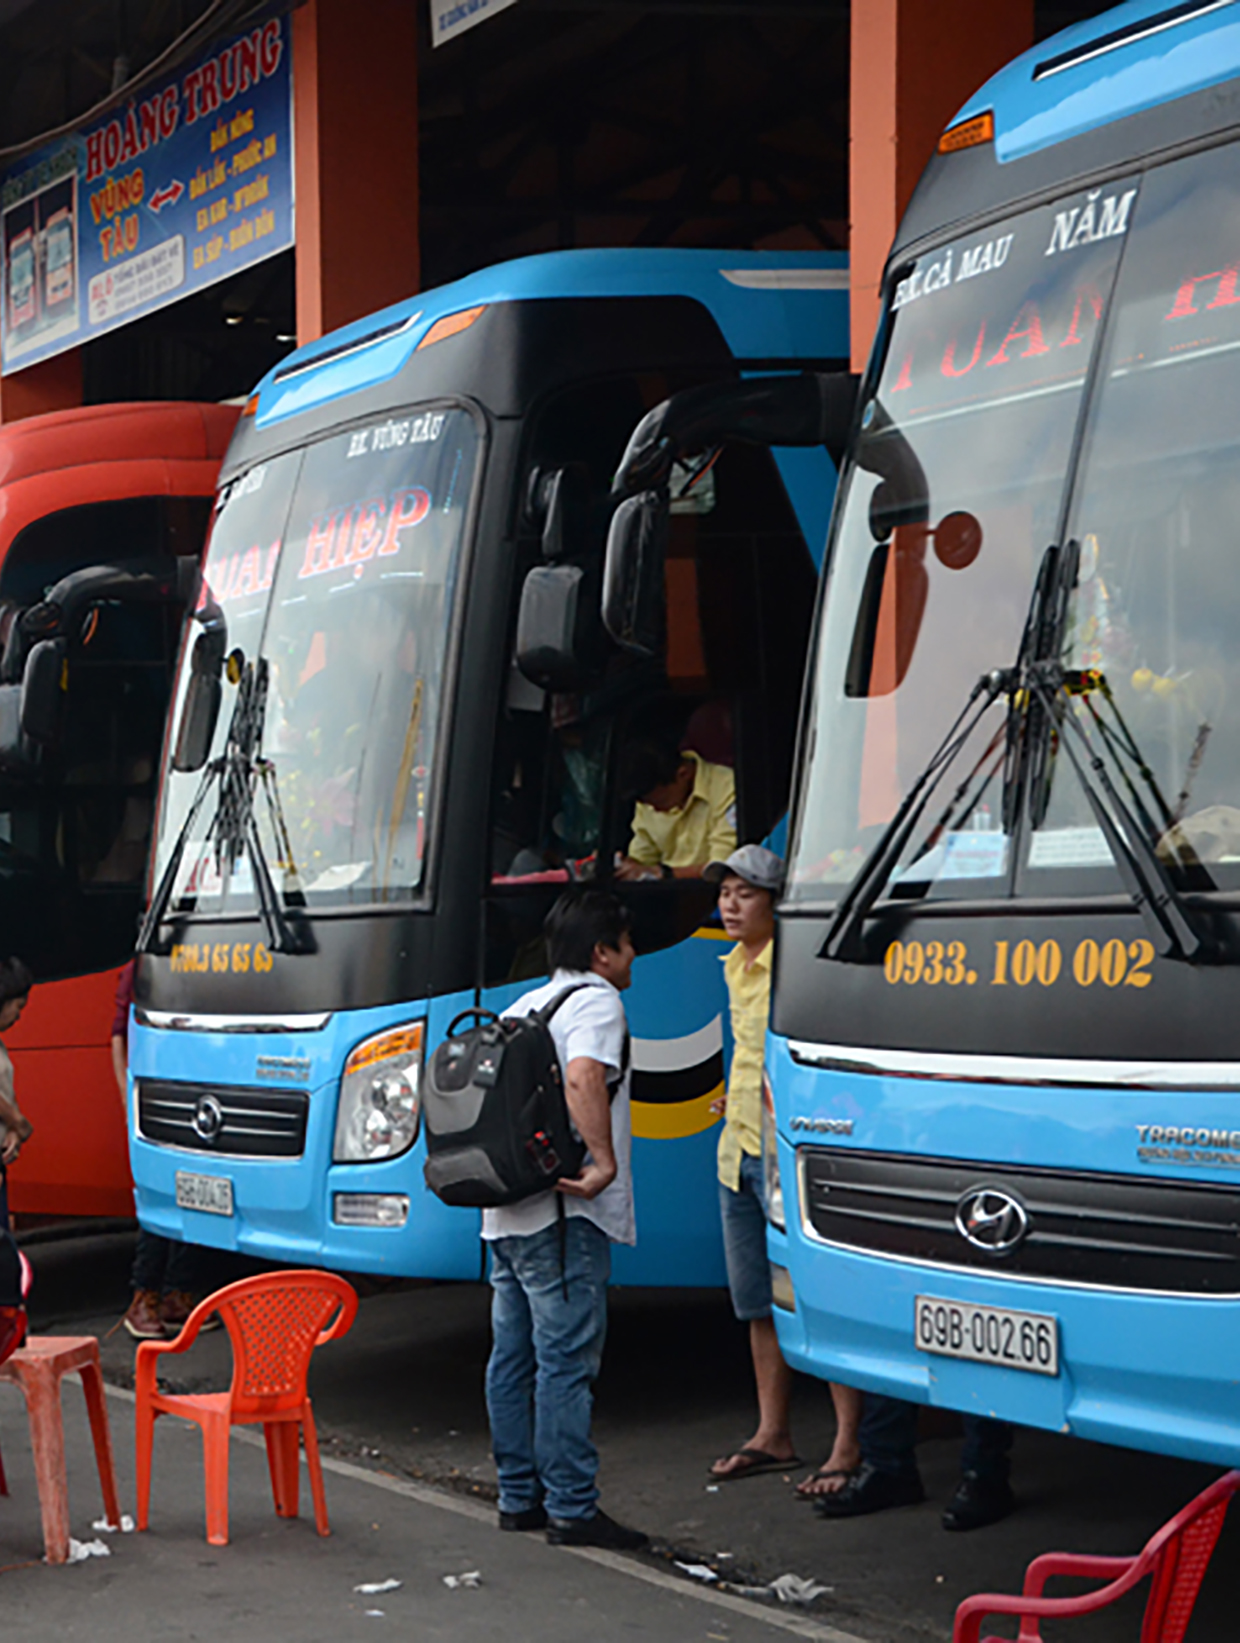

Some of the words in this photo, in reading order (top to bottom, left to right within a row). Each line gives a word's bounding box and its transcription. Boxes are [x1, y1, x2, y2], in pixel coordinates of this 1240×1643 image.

[183, 18, 283, 125] TRUNG
[955, 233, 1014, 282] MAU
[1045, 189, 1137, 256] NĂM
[298, 485, 431, 581] HIỆP
[884, 940, 978, 985] 0933.
[990, 939, 1062, 986] 100
[1073, 938, 1155, 988] 002
[920, 1303, 1052, 1366] 69B-002.66
